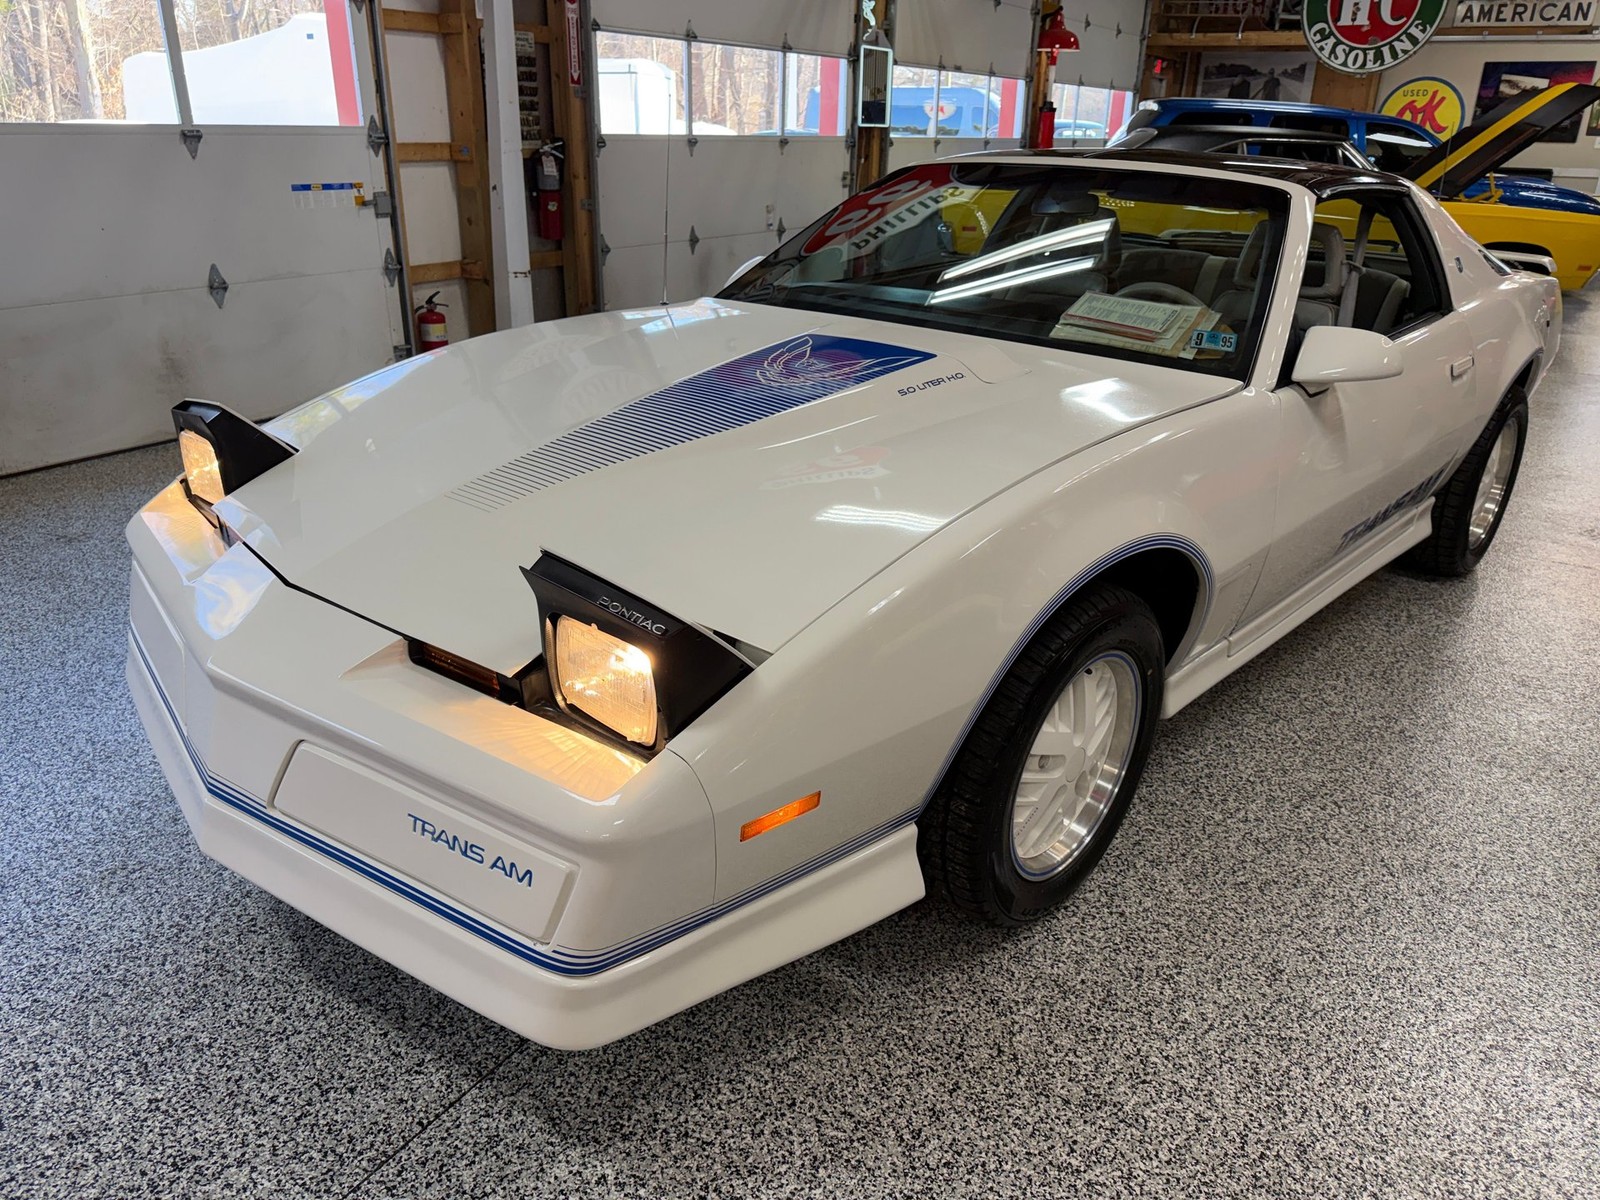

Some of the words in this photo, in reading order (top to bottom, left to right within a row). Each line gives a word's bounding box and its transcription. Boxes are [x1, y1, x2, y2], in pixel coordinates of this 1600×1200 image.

[1461, 2, 1592, 23] AMERICAN
[1309, 20, 1431, 69] GASOLINE
[1402, 89, 1429, 97] USED
[1195, 332, 1204, 346] 9
[1221, 336, 1233, 348] 95
[916, 377, 946, 391] LITER
[597, 596, 666, 635] PONTIAC
[408, 813, 485, 864] TRANS
[489, 856, 533, 887] AM
